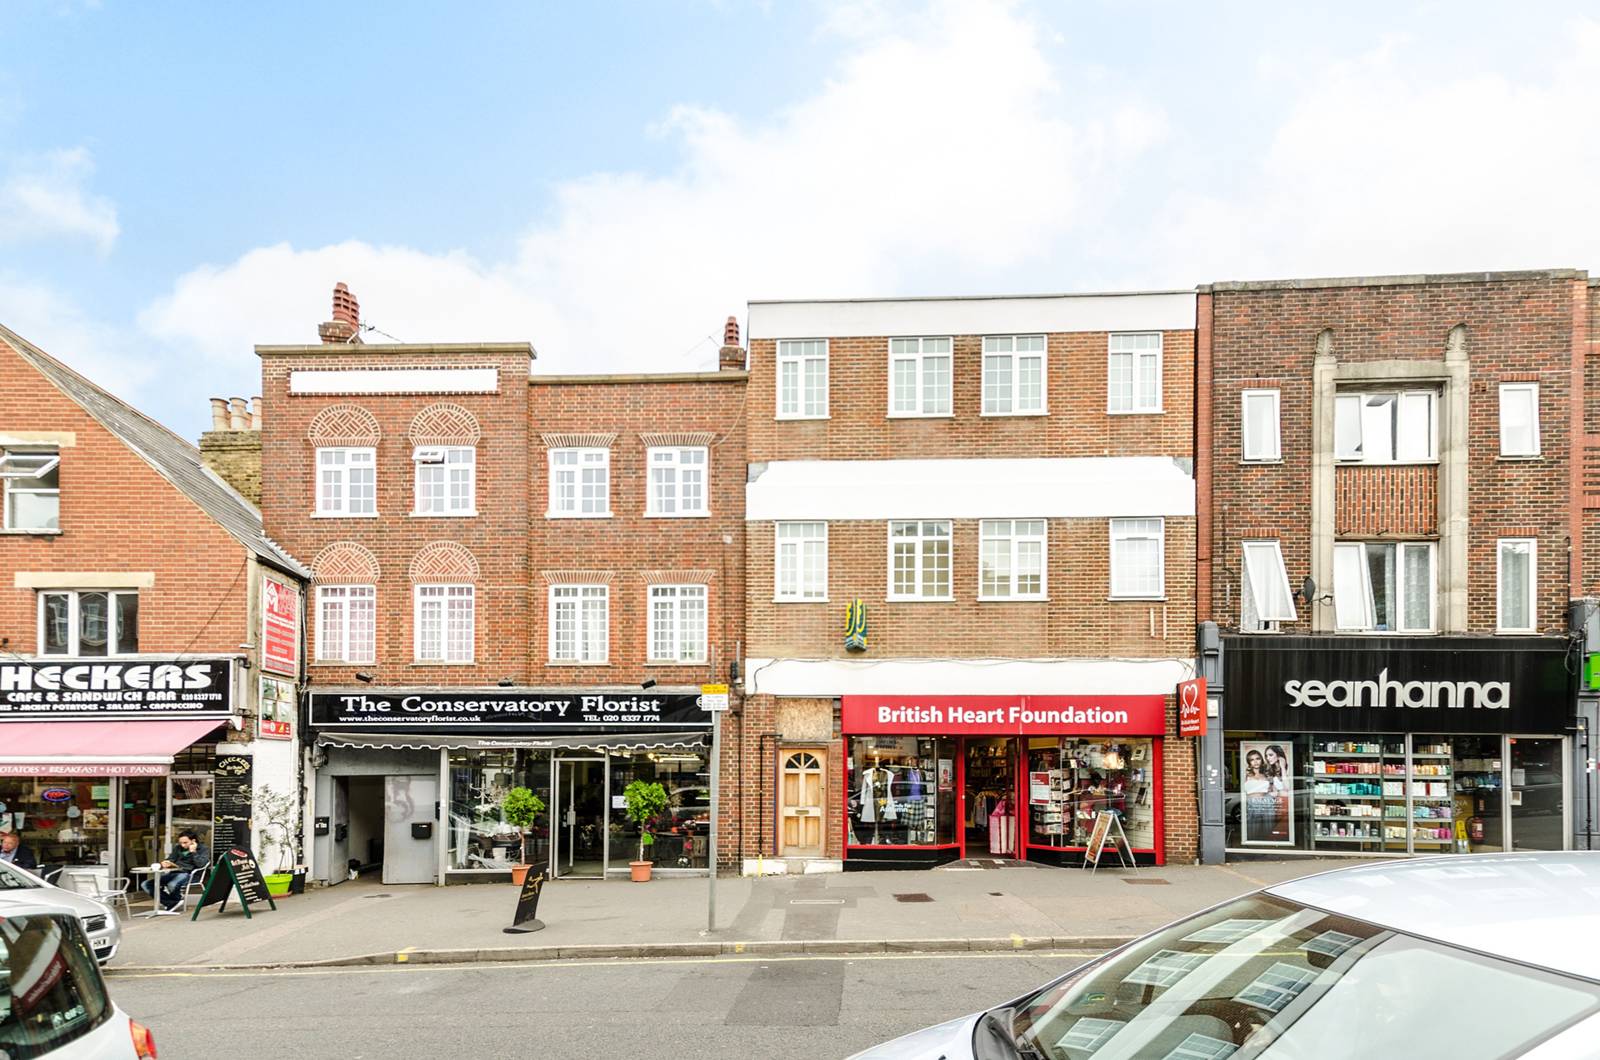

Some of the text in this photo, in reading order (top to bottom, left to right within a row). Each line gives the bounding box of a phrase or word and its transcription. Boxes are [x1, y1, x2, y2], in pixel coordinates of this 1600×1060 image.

[1284, 667, 1511, 709] seanhanna
[7, 692, 42, 702] CAFE
[45, 692, 59, 702] &
[62, 691, 142, 702] SANDWICH
[146, 691, 176, 701] BAR
[52, 703, 98, 711] POTATOES
[149, 702, 203, 710] CAPPUCCINO
[340, 695, 391, 712] The
[401, 695, 570, 717] Conservatory
[581, 695, 660, 712] Florist
[339, 714, 481, 723] www.theconservatoryflorist.co.uk
[602, 714, 619, 722] 020
[620, 714, 641, 722] 8337
[643, 714, 660, 722] 1774
[878, 706, 1128, 724] British Heart Foundation
[49, 766, 98, 774] BREAKFAST
[106, 766, 126, 774] HOT
[130, 766, 162, 774] PANINI
